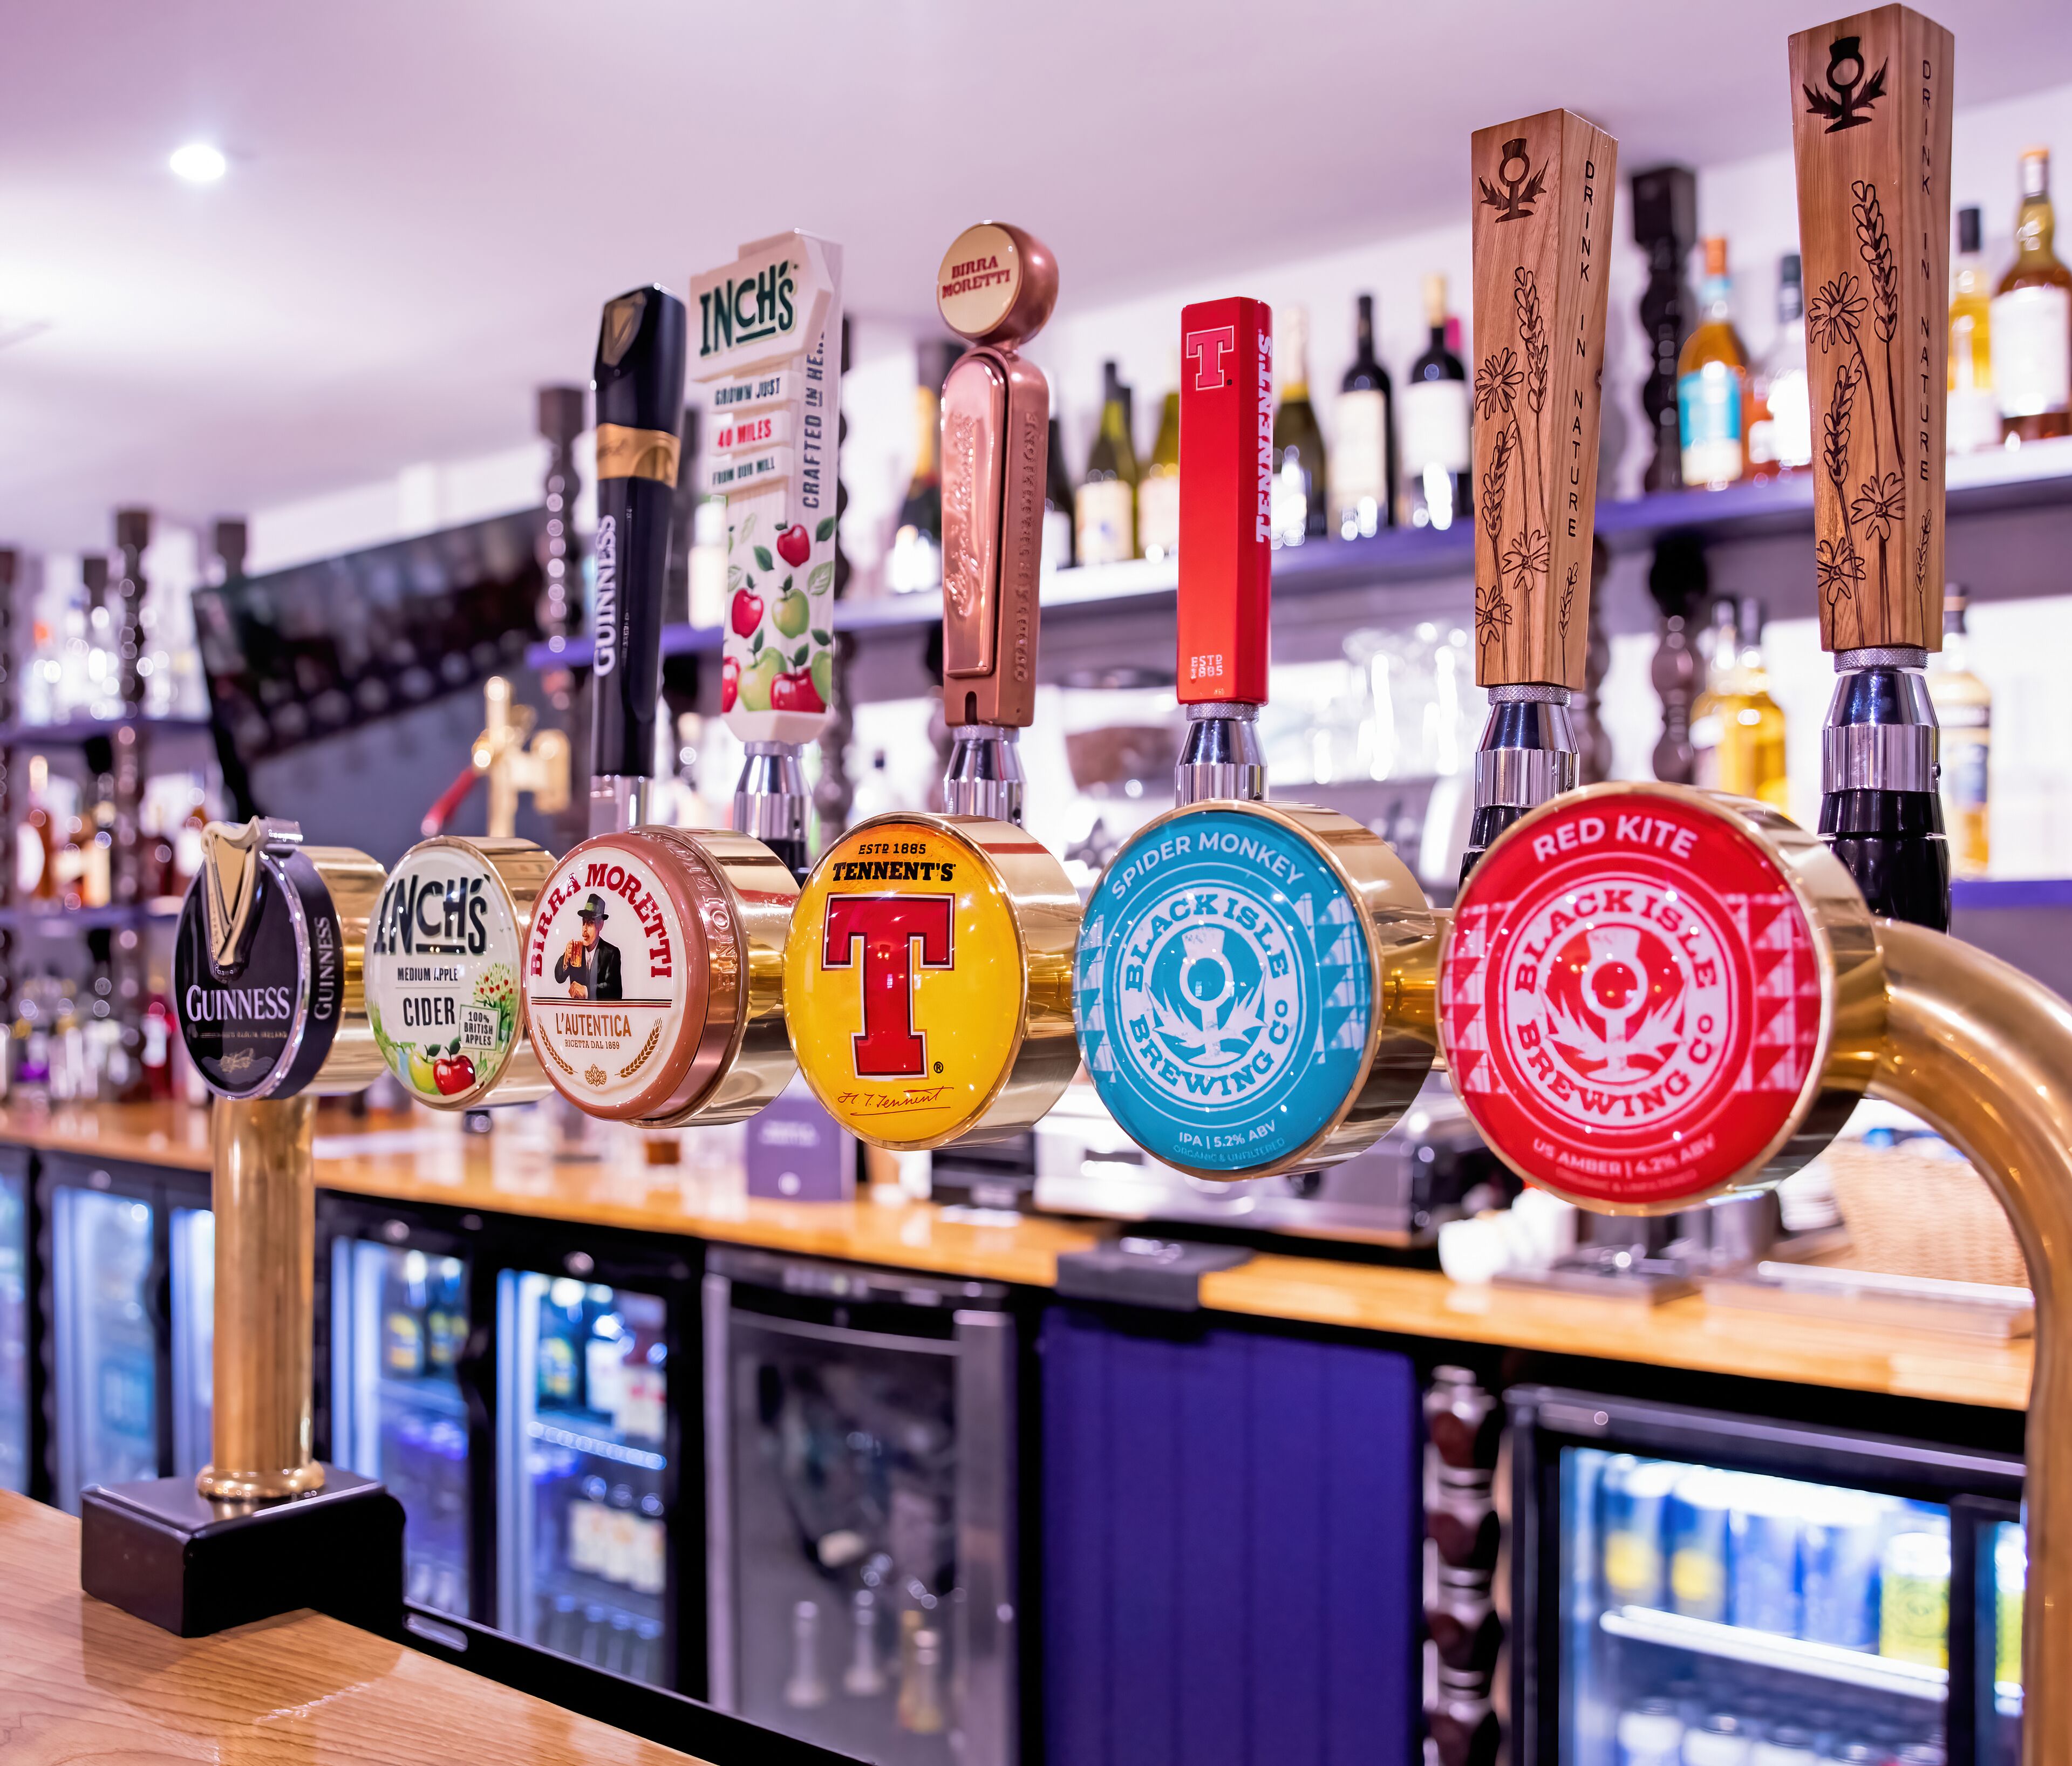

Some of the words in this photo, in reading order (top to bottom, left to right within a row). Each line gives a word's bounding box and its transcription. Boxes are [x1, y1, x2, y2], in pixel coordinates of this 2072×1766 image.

[1922, 59, 1931, 195] DRINK
[1580, 160, 1594, 282] DRINK
[951, 255, 998, 279] BIRRA
[1921, 233, 1930, 280] IN
[942, 269, 1011, 299] MORETTI
[1576, 313, 1586, 357] IN
[715, 383, 753, 406] GROWN
[756, 377, 781, 399] JUST
[805, 387, 820, 407] IN
[1919, 316, 1930, 481] NATURE
[718, 428, 733, 448] 40
[737, 418, 772, 445] MILES
[1256, 333, 1273, 543] TENNENT'S
[712, 468, 734, 486] FROM
[756, 456, 775, 474] MILL
[802, 414, 822, 509] CRAFTED
[1567, 388, 1583, 537] NATURE
[593, 515, 616, 677] GUINNESS
[1190, 665, 1223, 679] 1885
[1191, 654, 1223, 667] ESTD
[858, 843, 889, 855] ESTD
[893, 843, 926, 855] 1885
[1532, 816, 1606, 862] RED
[1615, 814, 1699, 860] KITE
[833, 861, 955, 882] TENNENT'S
[1112, 835, 1191, 901] SPIDER
[1198, 831, 1306, 885] MONKEY
[530, 872, 582, 978] BIRRA
[585, 863, 672, 978] MORETTI
[1125, 893, 1219, 993] BLACK
[1223, 897, 1290, 979] ISLE
[1514, 889, 1634, 995] BLACK
[1640, 895, 1718, 990] ISLE
[314, 917, 335, 1021] GUINNESS
[398, 967, 431, 981] MEDIUM
[434, 967, 459, 981] APPLE
[821, 892, 956, 1079] T
[186, 984, 290, 1022] GUINNESS
[403, 997, 456, 1026] CIDER
[468, 1011, 490, 1024] 100%
[464, 1022, 493, 1035] BRITISH
[465, 1034, 492, 1046] APPLES
[556, 1012, 632, 1037] L'AUTENTICA
[564, 1039, 590, 1048] RICETTA
[591, 1040, 604, 1049] DAL
[1129, 1014, 1276, 1096] BREWING
[1517, 1019, 1693, 1118] BREWING
[1179, 1132, 1203, 1147] IPA
[1214, 1133, 1245, 1148] 5.2%
[1249, 1119, 1276, 1142] ABV
[1556, 1151, 1622, 1177] AMBER
[1679, 1133, 1717, 1164] ABV
